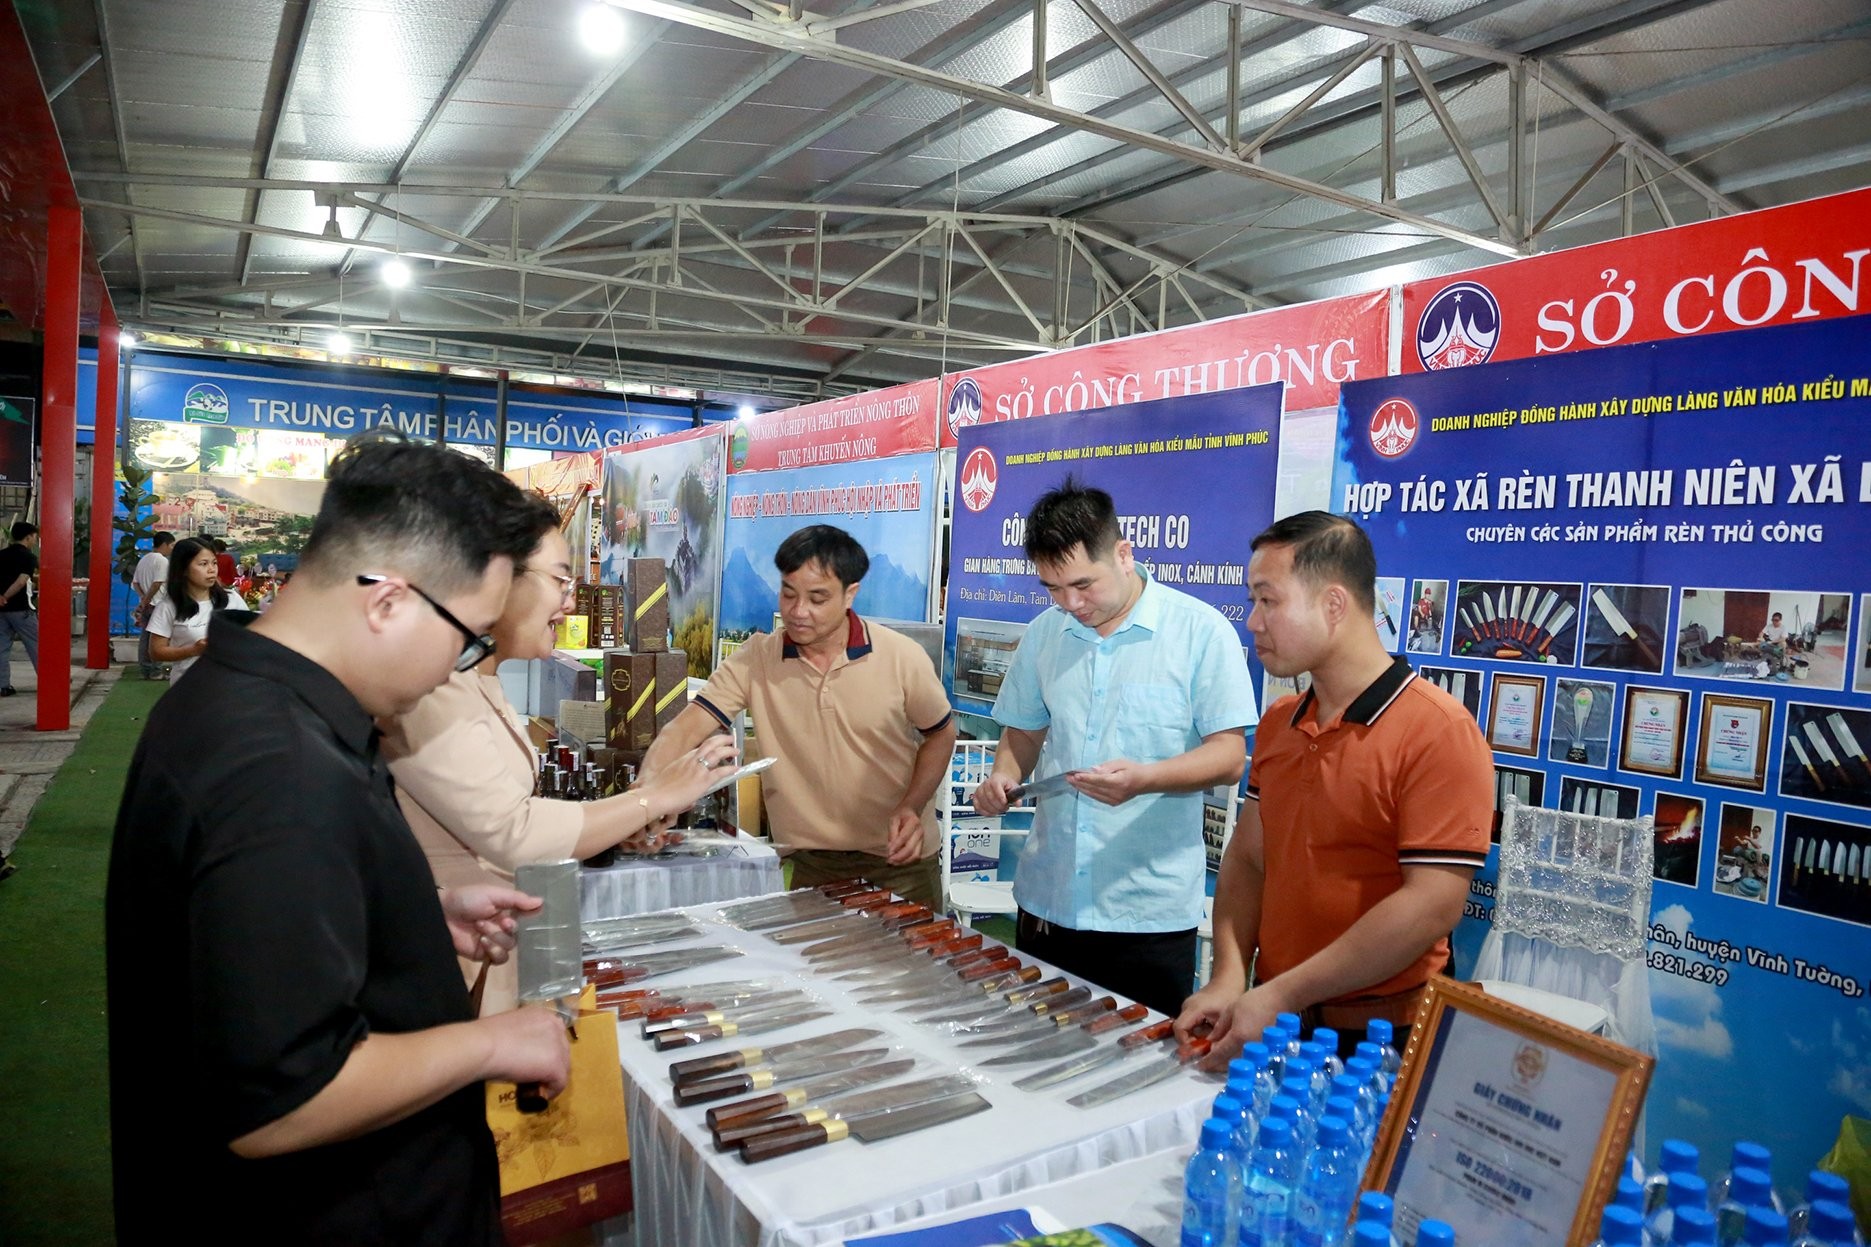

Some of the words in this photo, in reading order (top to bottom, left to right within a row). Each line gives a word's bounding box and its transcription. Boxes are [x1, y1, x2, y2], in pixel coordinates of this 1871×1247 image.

[1535, 269, 1636, 354] SỞ
[1663, 247, 1871, 334] CÔN
[995, 376, 1035, 423] SỞ
[1044, 371, 1141, 414] CÔNG
[1154, 337, 1360, 399] THƯƠNG
[248, 398, 354, 429] TRUNG
[360, 403, 421, 435] TÂM
[506, 413, 569, 446] PHỐI
[572, 420, 603, 448] VÀ
[818, 407, 839, 431] PHÁT
[839, 397, 865, 427] TRIỂN
[866, 397, 891, 422] NÔNG
[893, 390, 920, 418] THÔN
[1431, 415, 1470, 432] DOANH
[1473, 408, 1517, 429] NGHIỆP
[1520, 403, 1556, 425] ĐỒNG
[1559, 402, 1596, 421] HÀNH
[1600, 397, 1628, 417] XÂY
[1632, 395, 1672, 417] DỰNG
[1676, 391, 1718, 411] LÀNG
[1723, 386, 1757, 408] VĂN
[1761, 382, 1797, 404] HÓA
[1802, 374, 1845, 401] KIỂU
[778, 448, 801, 467] TRUNG
[802, 441, 818, 464] TÂM
[819, 434, 852, 461] KHUYẾN
[852, 433, 877, 458] NÔNG
[1005, 454, 1025, 465] DOANH
[1025, 450, 1046, 465] NGHIỆP
[1046, 447, 1062, 462] ĐỒNG
[1063, 447, 1080, 460] HÀNH
[1081, 445, 1094, 458] XÂY
[1095, 445, 1113, 460] DỰNG
[1114, 442, 1132, 456] LÀNG
[1134, 440, 1148, 454] VĂN
[1150, 438, 1164, 453] HÓA
[1166, 434, 1183, 451] KIỂU
[1185, 433, 1202, 450] MẪU
[1204, 432, 1222, 449] TỈNH
[1225, 432, 1244, 447] VĨNH
[1245, 428, 1269, 445] PHÚC
[884, 476, 901, 512] PHÁT
[901, 470, 921, 511] TRIỂN
[1343, 480, 1392, 519] HỢP
[1400, 475, 1446, 512] TÁC
[1453, 472, 1489, 511] XÃ
[1498, 469, 1557, 510] RÈN
[1566, 469, 1673, 508] THANH
[1683, 458, 1776, 506] NIÊN
[1787, 454, 1845, 504] XÃ
[1002, 513, 1028, 547] CÔN
[1165, 515, 1190, 549] CO
[1466, 523, 1526, 544] CHUYÊN
[1530, 523, 1560, 543] CÁC
[1565, 521, 1598, 543] SẢN
[1604, 518, 1657, 543] PHẨM
[1664, 521, 1704, 543] RÈN
[1711, 520, 1754, 543] THỦ
[1760, 520, 1823, 543] CÔNG
[964, 557, 981, 573] GIAN
[981, 555, 1000, 574] HÀNG
[1002, 557, 1026, 575] TRƯNG
[1144, 556, 1156, 574] ẾP
[1158, 563, 1184, 585] INOX,
[1187, 561, 1215, 584] CÁNH
[1217, 561, 1244, 585] KÍNH
[960, 587, 972, 602] Địa
[1030, 592, 1048, 605] Tam
[967, 838, 991, 849] one
[1686, 932, 1740, 963] huyện
[1747, 947, 1788, 975] Vĩnh
